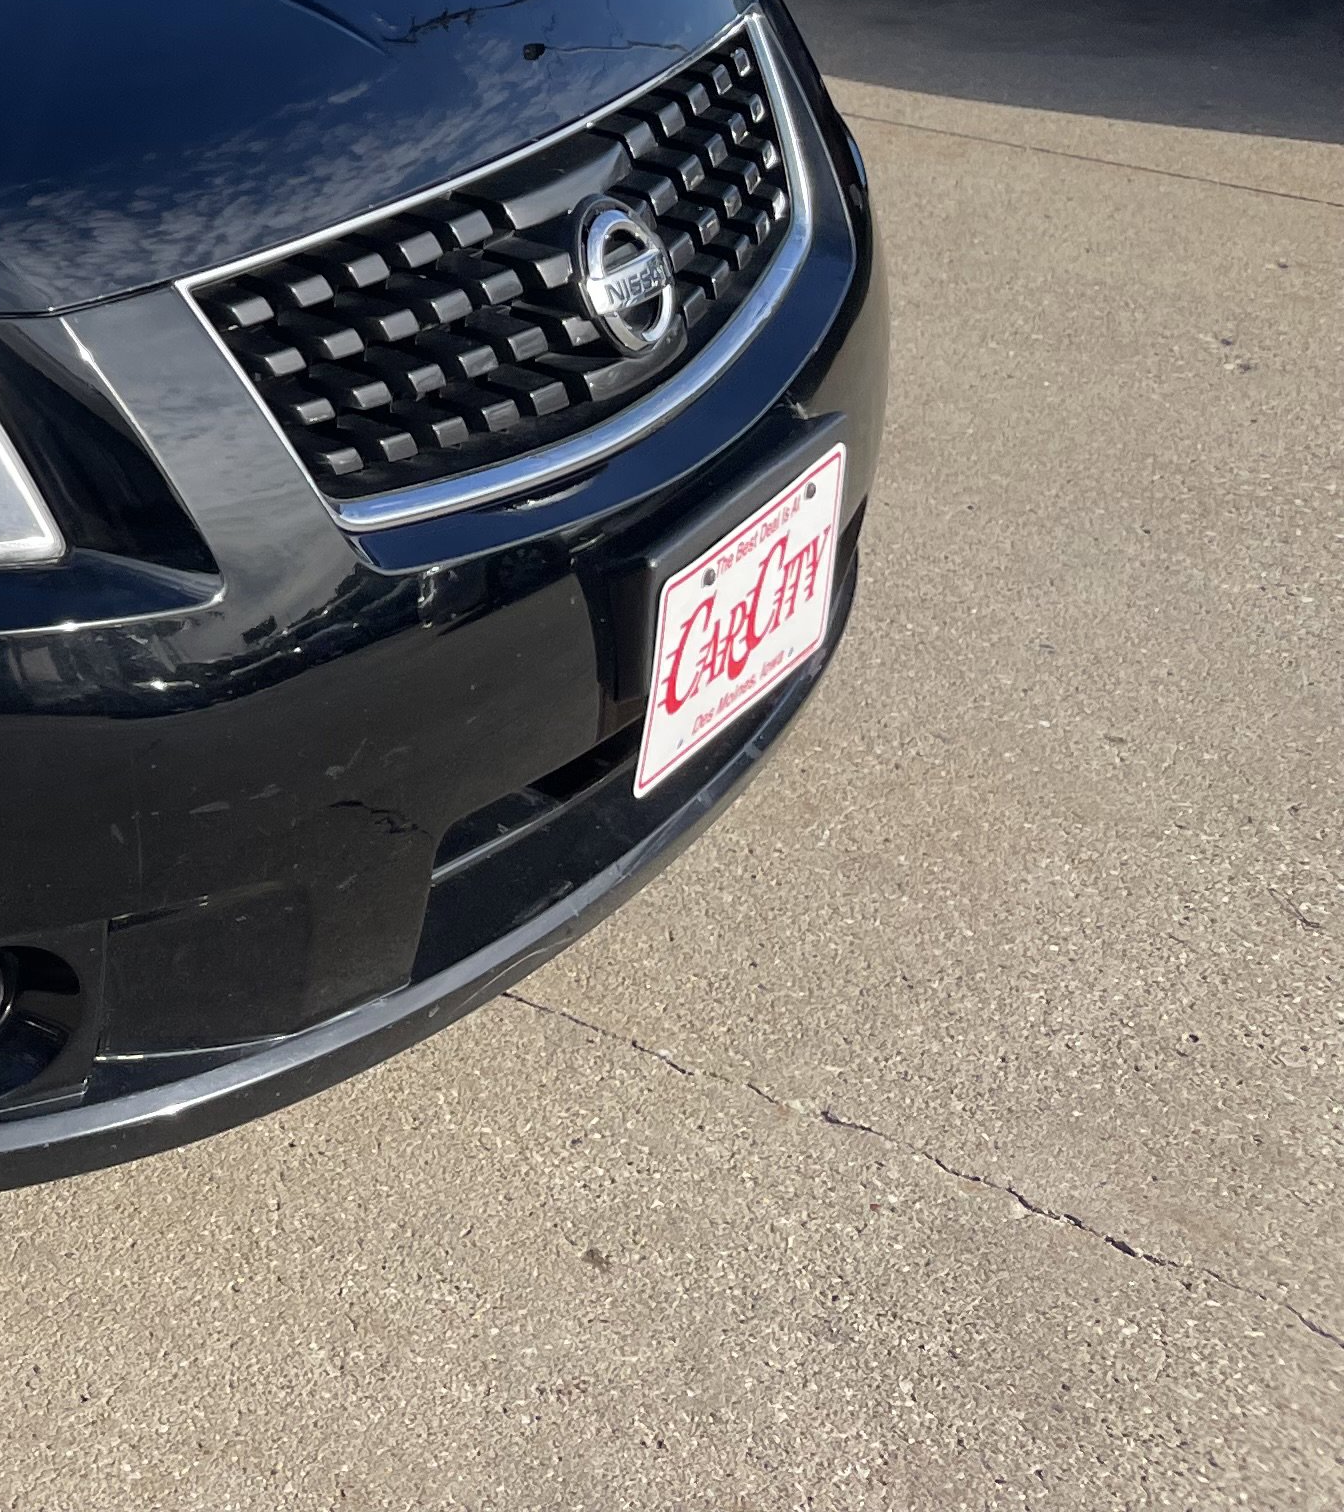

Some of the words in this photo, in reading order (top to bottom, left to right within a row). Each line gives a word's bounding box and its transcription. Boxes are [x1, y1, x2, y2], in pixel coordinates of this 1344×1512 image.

[716, 553, 735, 578] The
[735, 530, 758, 563] Best
[760, 511, 781, 543] Deal
[692, 708, 715, 735] Des
[760, 650, 784, 680] Iowa
